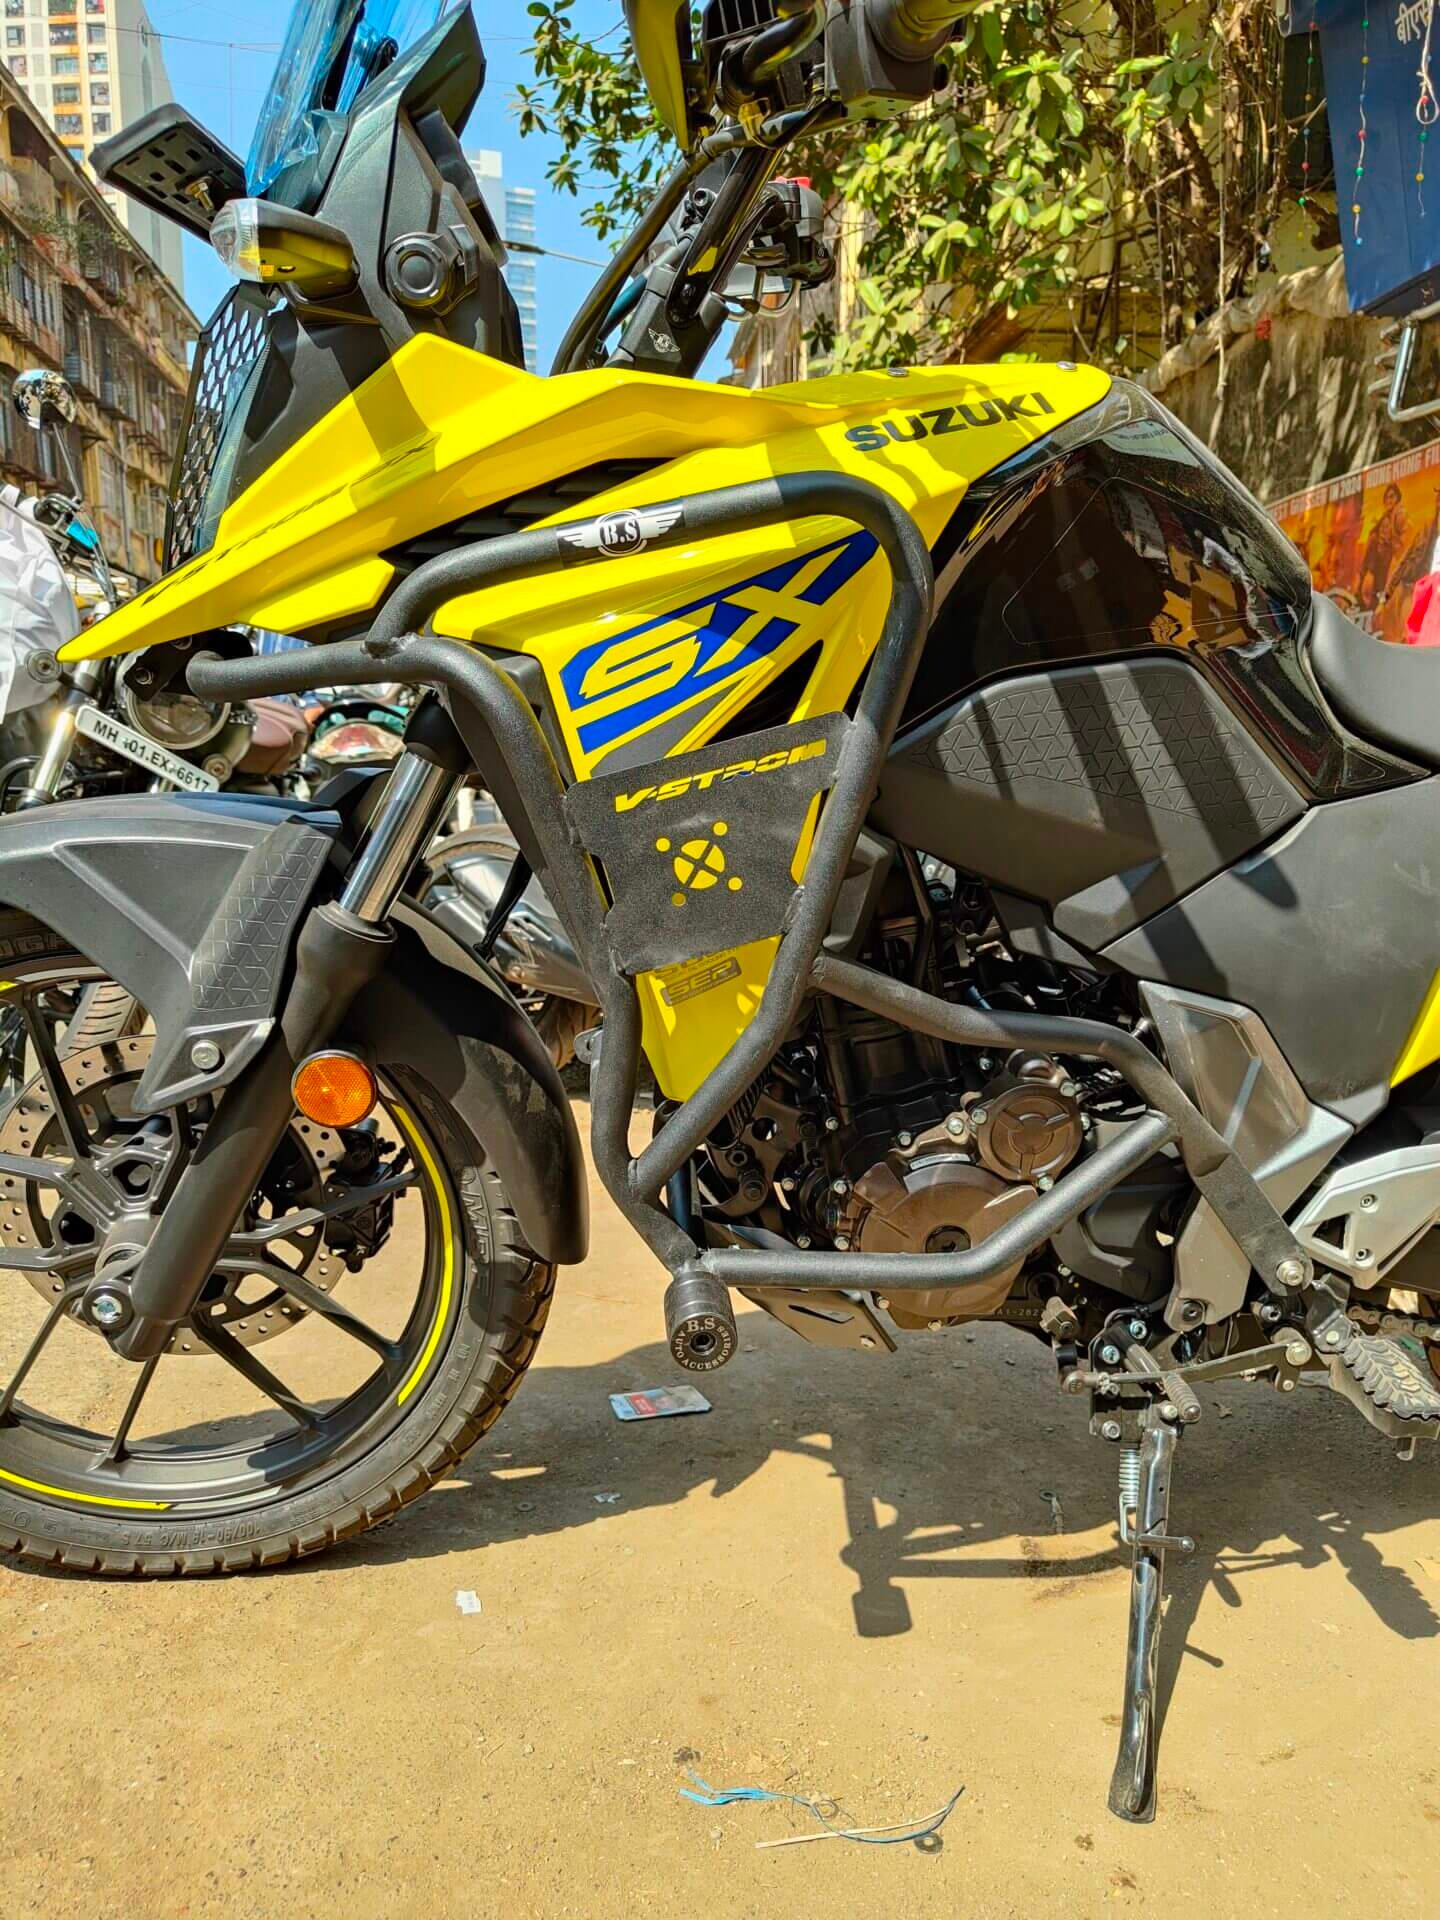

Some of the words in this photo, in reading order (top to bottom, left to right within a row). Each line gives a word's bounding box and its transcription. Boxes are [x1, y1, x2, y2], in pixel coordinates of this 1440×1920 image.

[845, 392, 1056, 451] SUZUKI
[601, 519, 638, 545] B.S
[93, 719, 119, 743] MH
[687, 1318, 715, 1332] B.S
[675, 1330, 686, 1358] AUTO
